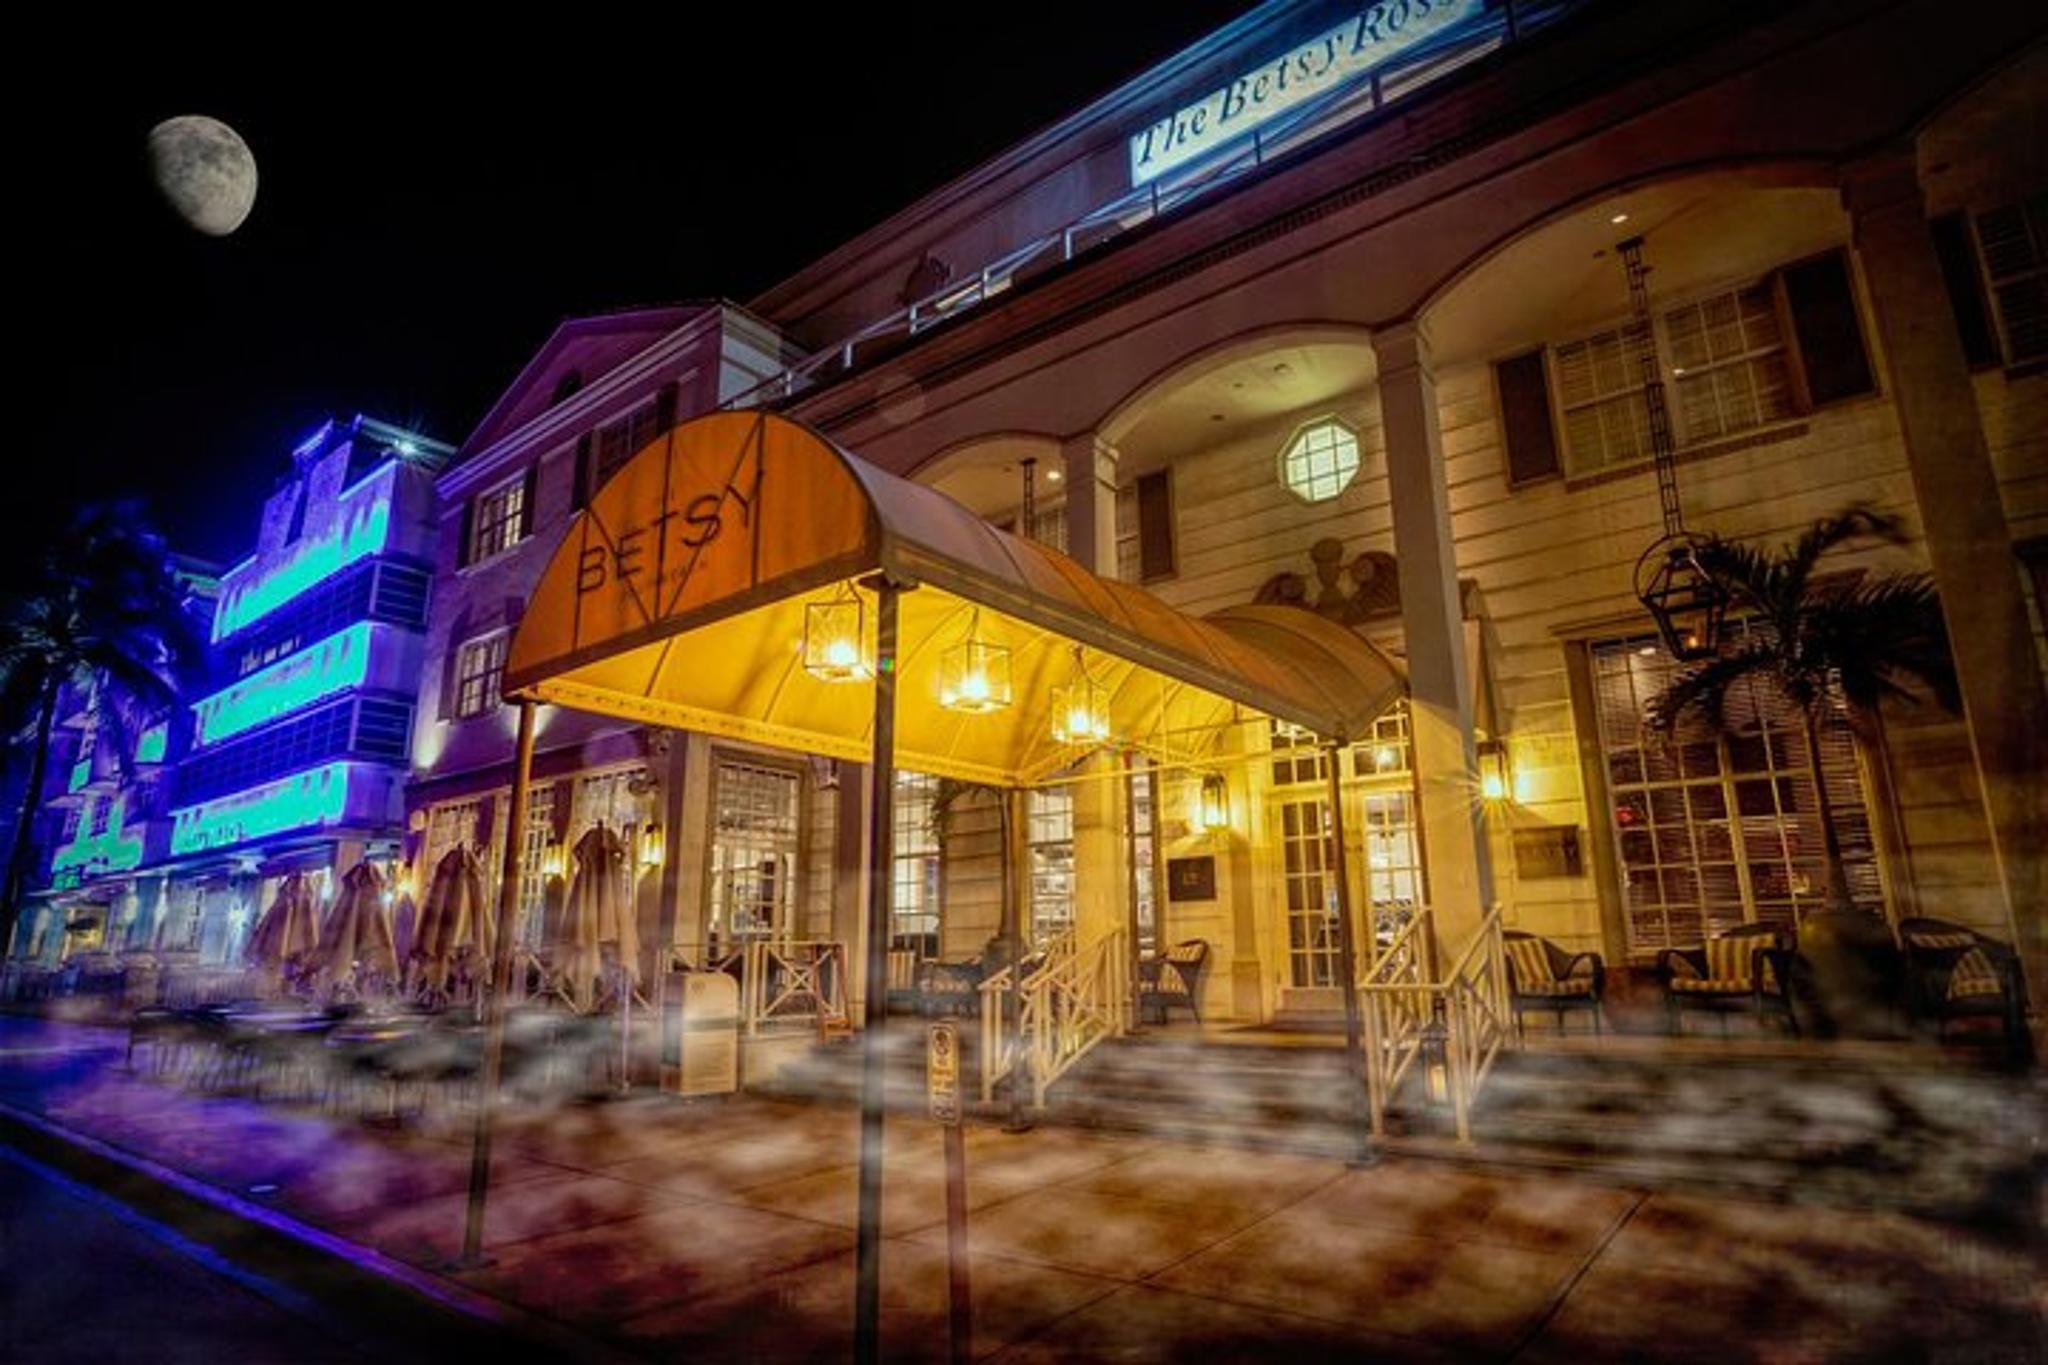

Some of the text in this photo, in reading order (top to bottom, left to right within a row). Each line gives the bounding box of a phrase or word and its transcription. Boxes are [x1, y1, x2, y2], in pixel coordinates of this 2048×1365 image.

[1135, 0, 1449, 167] The Betsy Ros
[577, 470, 762, 594] BETSY
